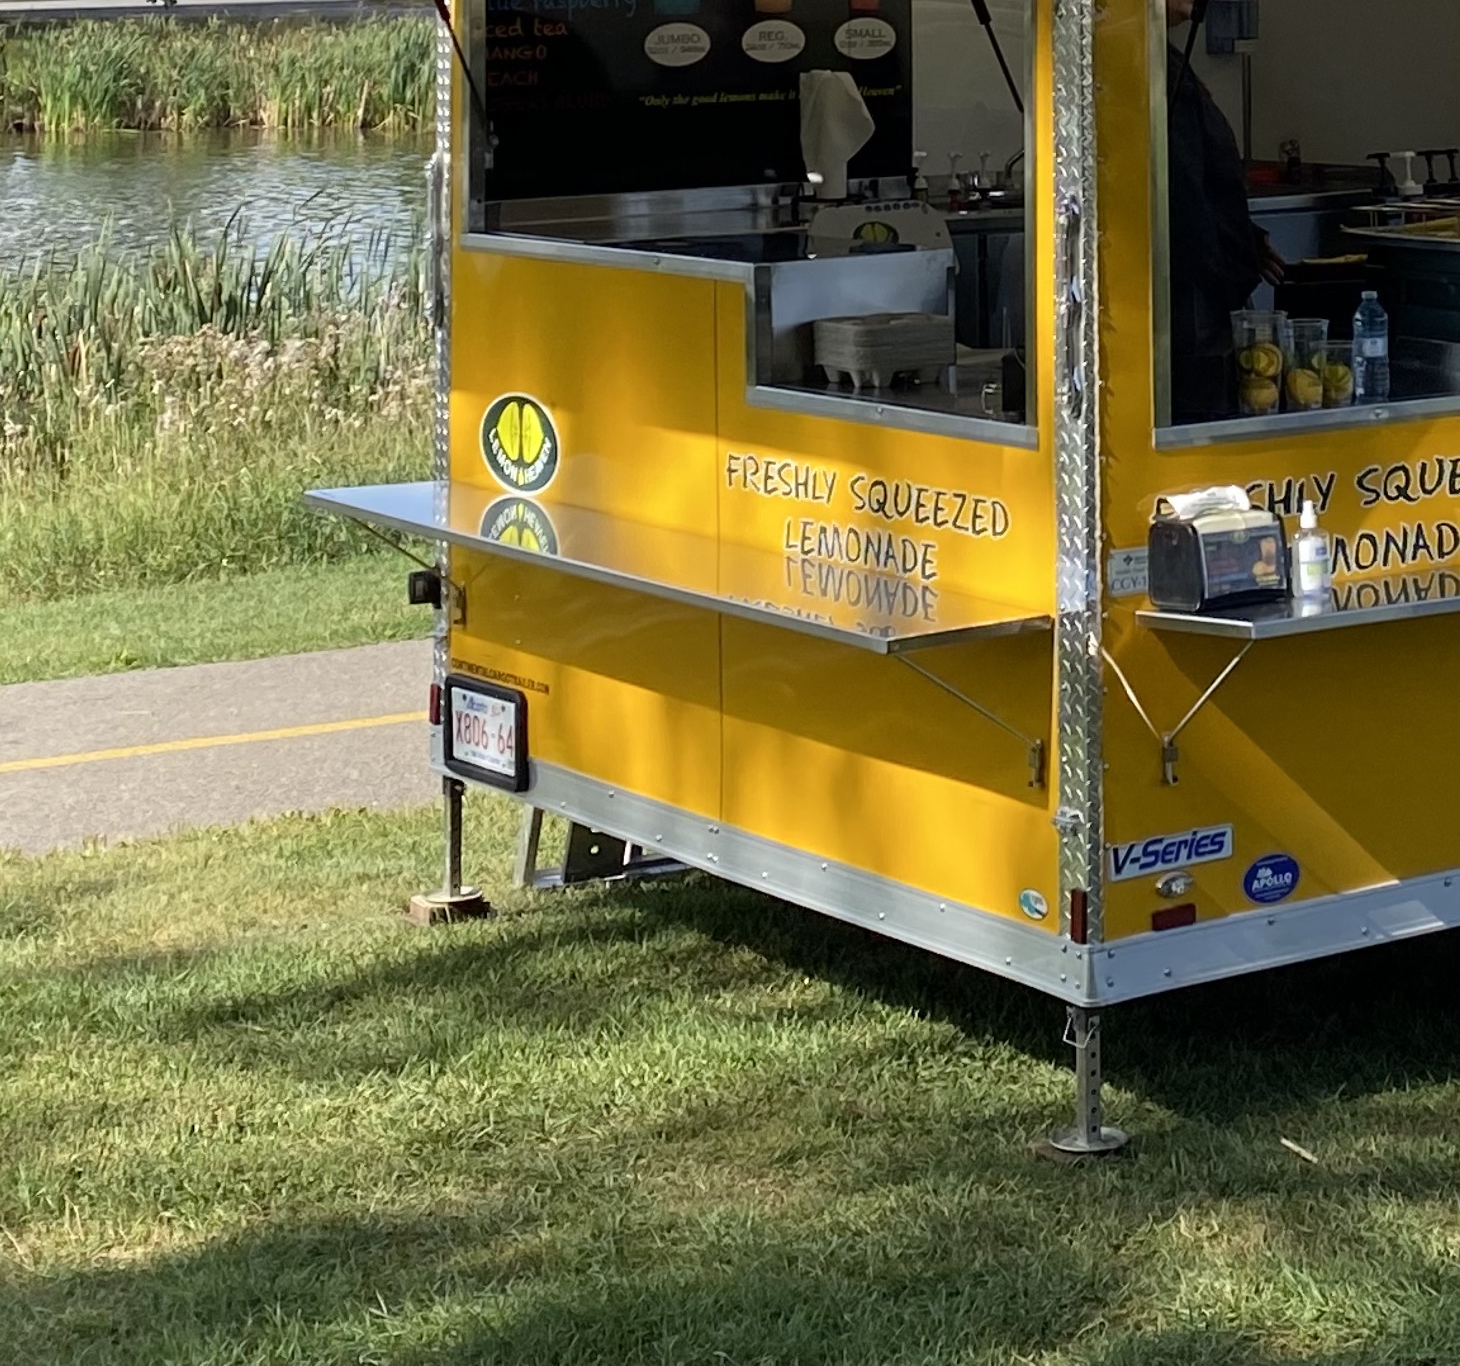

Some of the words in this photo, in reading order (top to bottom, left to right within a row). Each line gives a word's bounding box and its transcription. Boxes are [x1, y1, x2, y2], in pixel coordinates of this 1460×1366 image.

[486, 17, 522, 37] ced
[534, 17, 568, 36] tea
[845, 29, 886, 39] SMALL
[655, 34, 702, 45] JUMBO
[486, 44, 547, 61] ANGO
[487, 70, 540, 87] EACH
[488, 427, 519, 483] LEMON
[523, 436, 552, 485] HEAVEN
[727, 453, 837, 504] FRESHLY
[850, 474, 1010, 537] SQUEEZED
[785, 519, 938, 580] LEMONADE
[1112, 829, 1228, 876] V-Series
[1251, 872, 1293, 892] APOLLO
